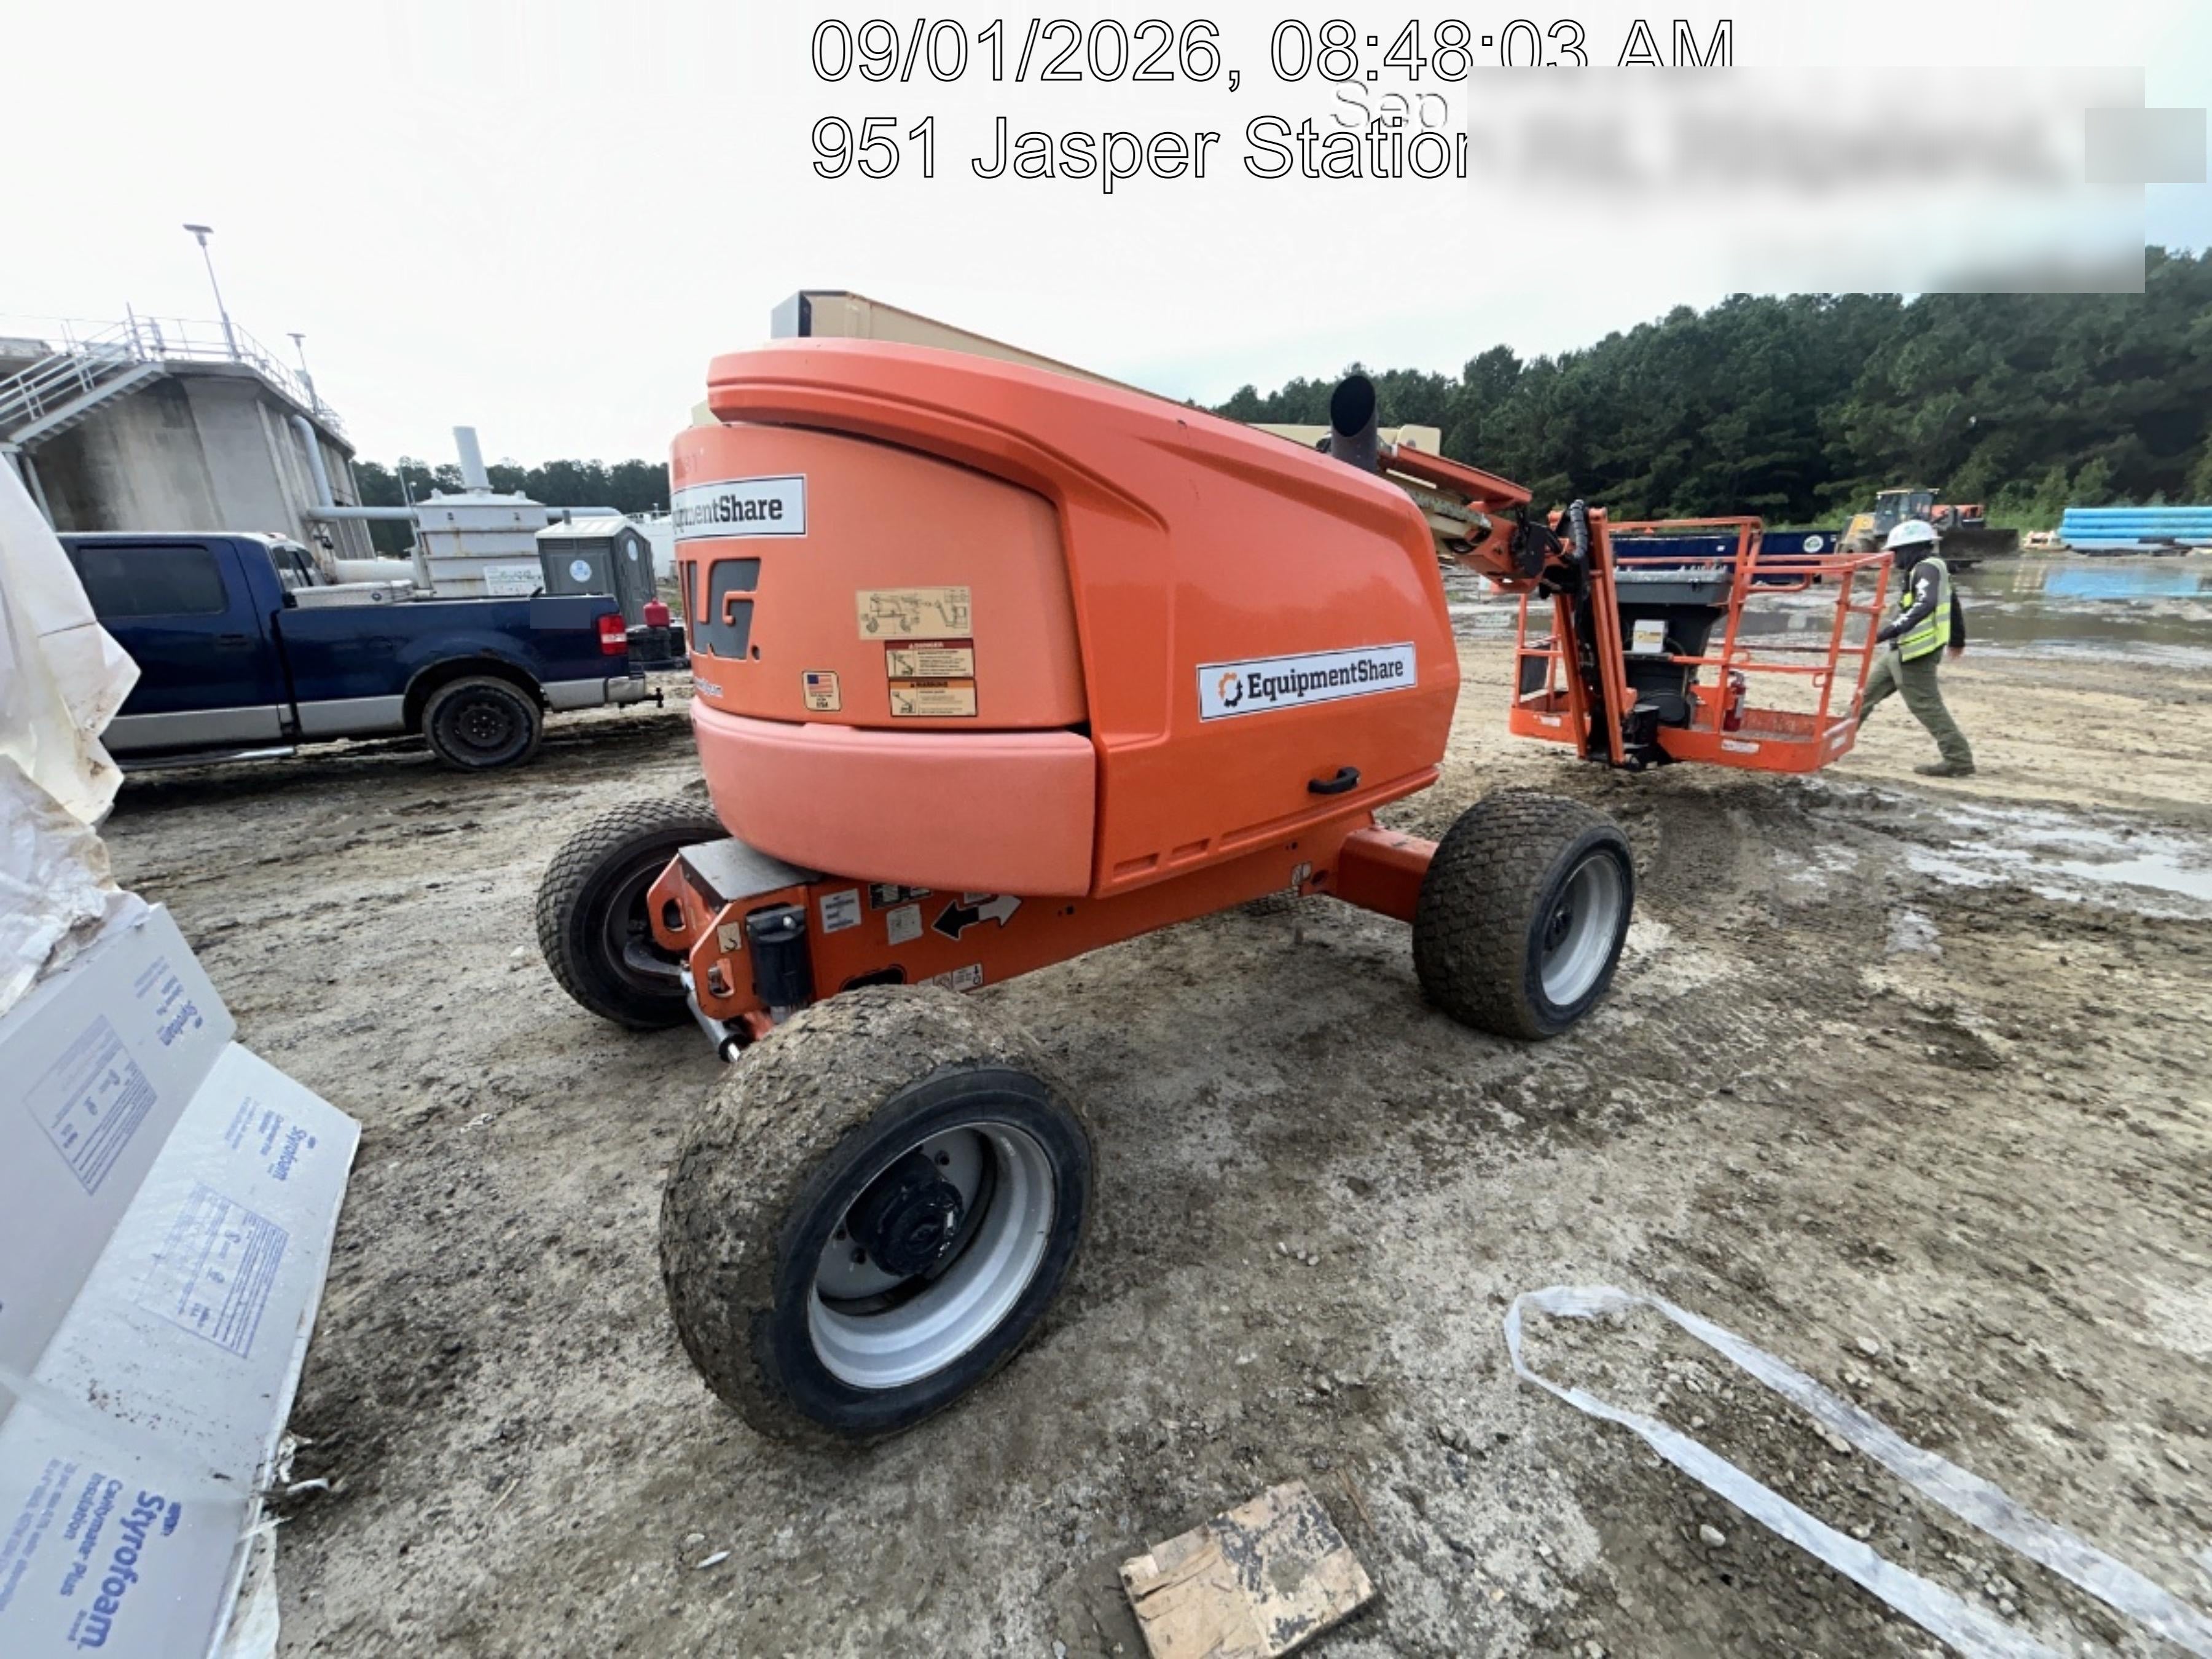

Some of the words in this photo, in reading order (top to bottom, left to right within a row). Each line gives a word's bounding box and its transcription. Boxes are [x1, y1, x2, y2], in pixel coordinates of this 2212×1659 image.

[679, 556, 761, 661] LG
[1247, 659, 1404, 702] EquipmentShare
[80, 1489, 165, 1649] Styrofoam
